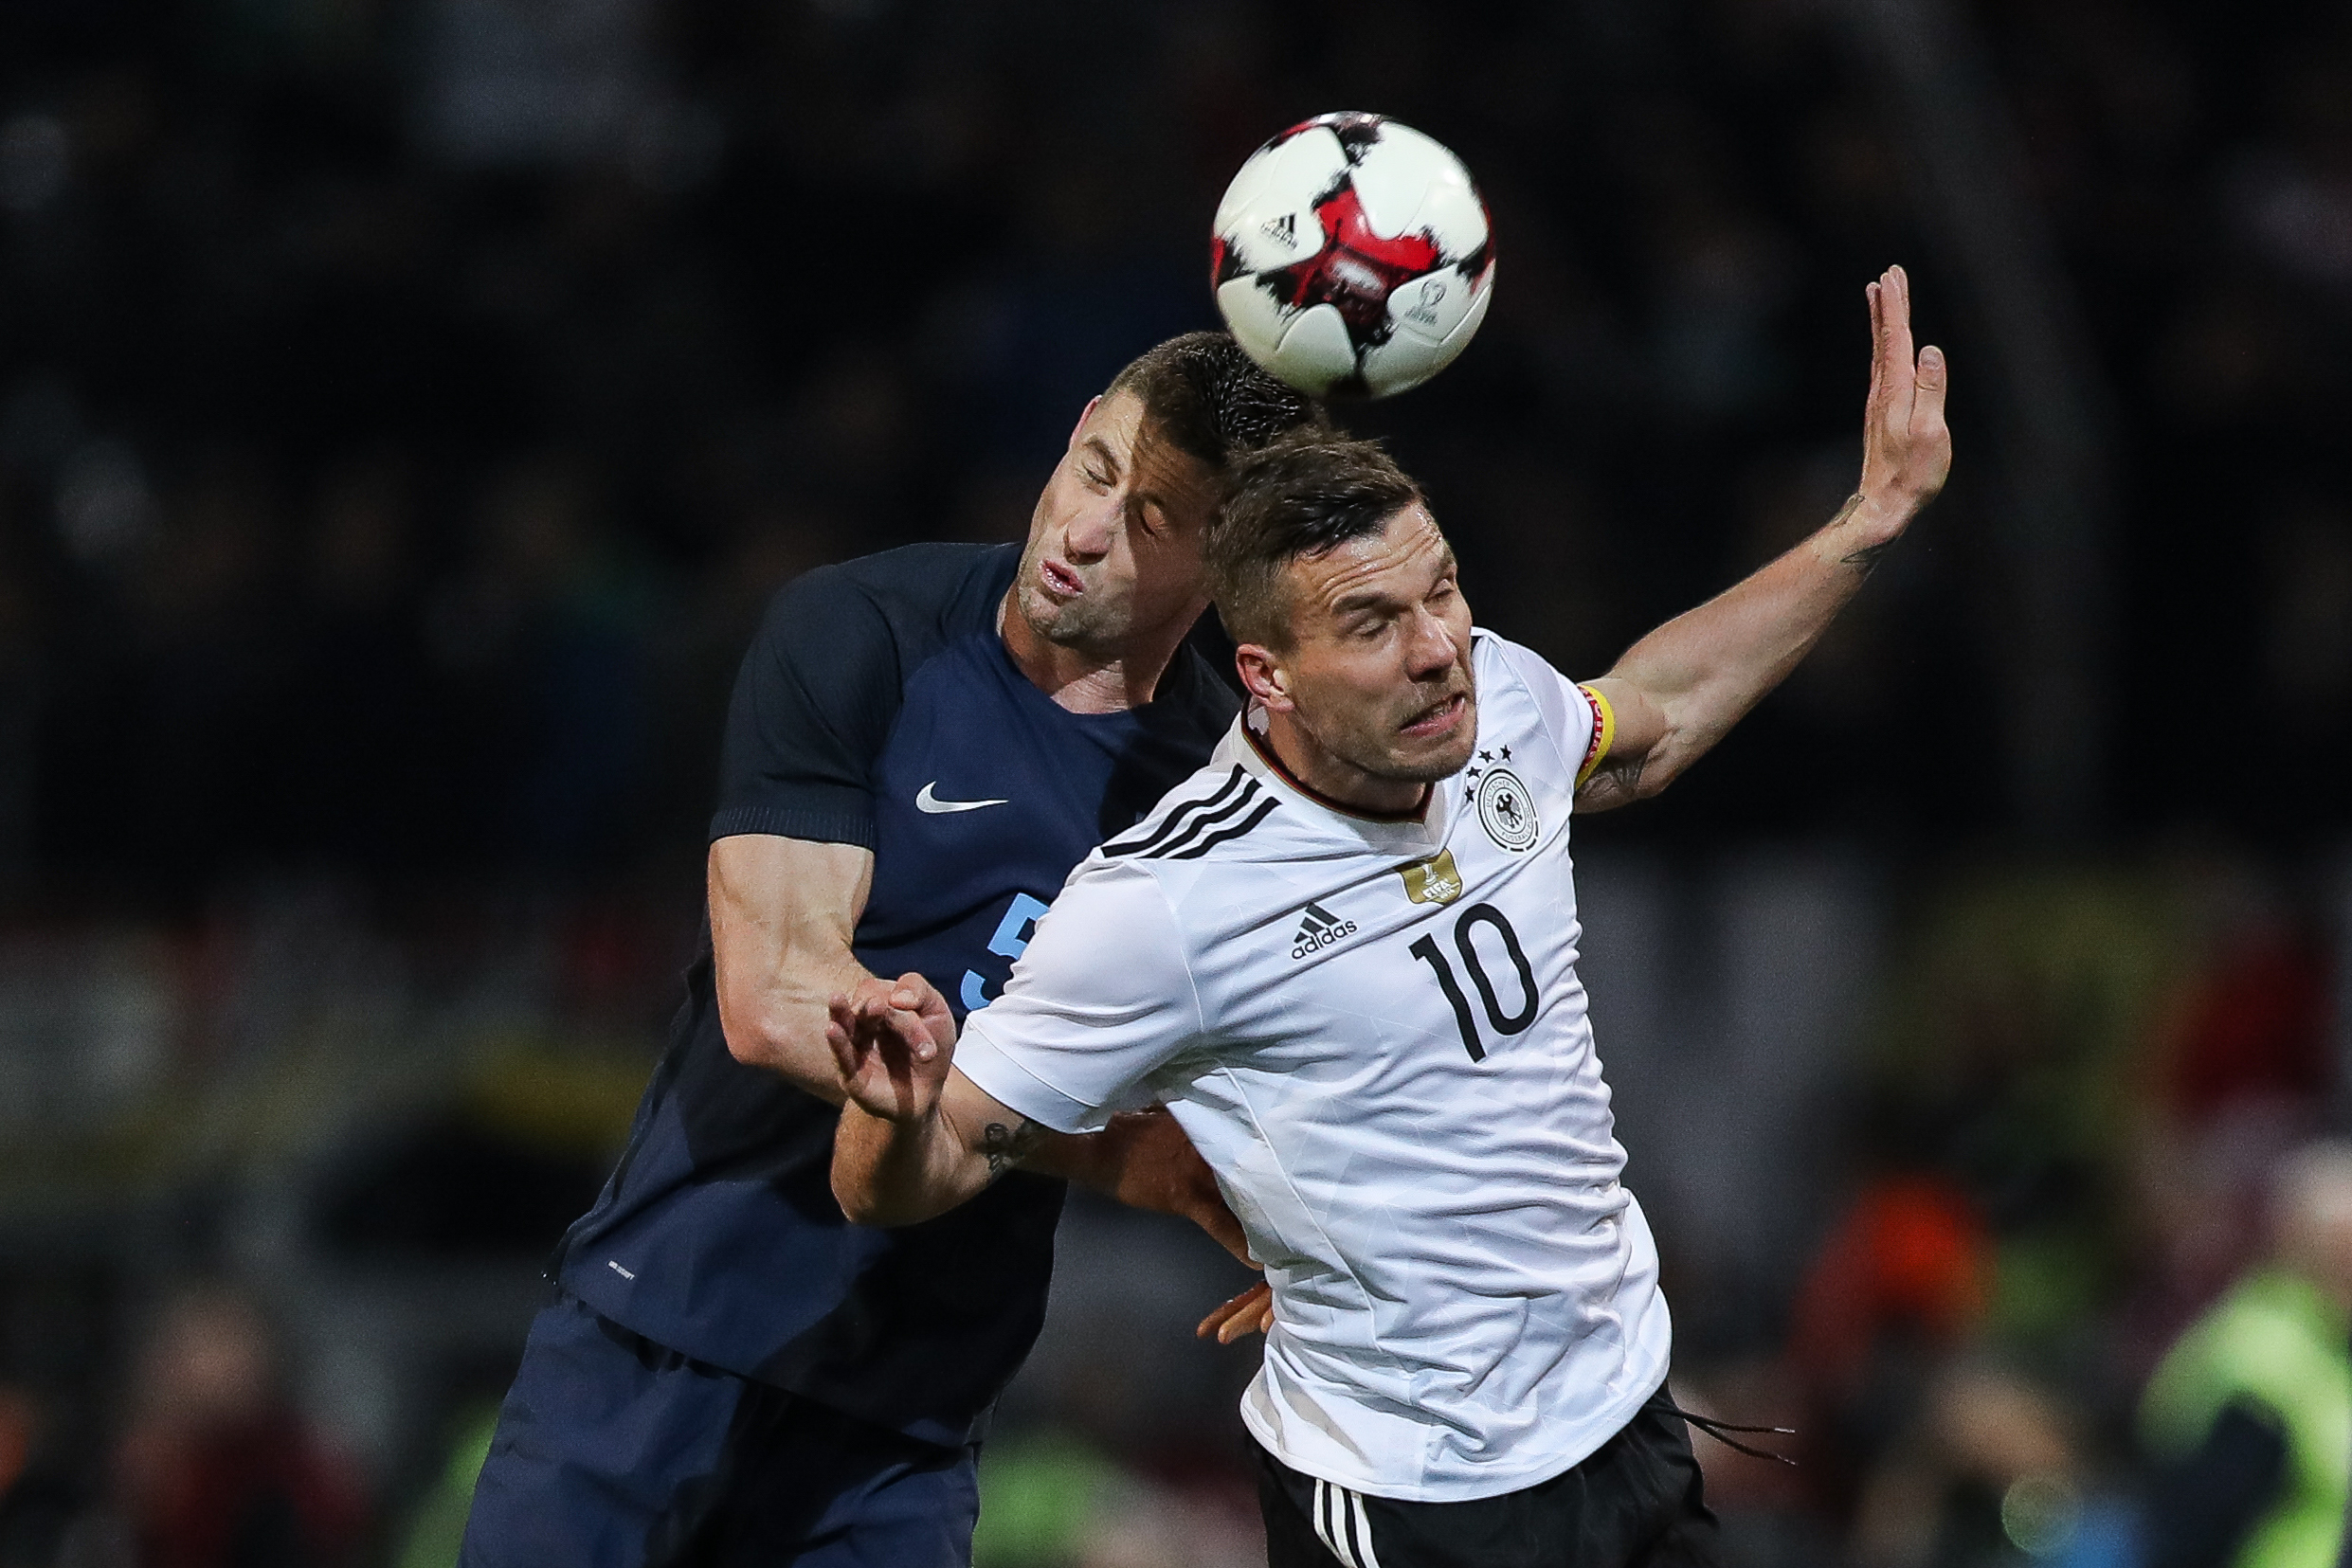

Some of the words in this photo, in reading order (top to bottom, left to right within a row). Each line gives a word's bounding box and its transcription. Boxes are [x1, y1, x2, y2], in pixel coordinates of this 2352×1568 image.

[1422, 879, 1452, 898] FIFA
[1292, 920, 1358, 960] adidas
[1408, 903, 1539, 1063] 10
